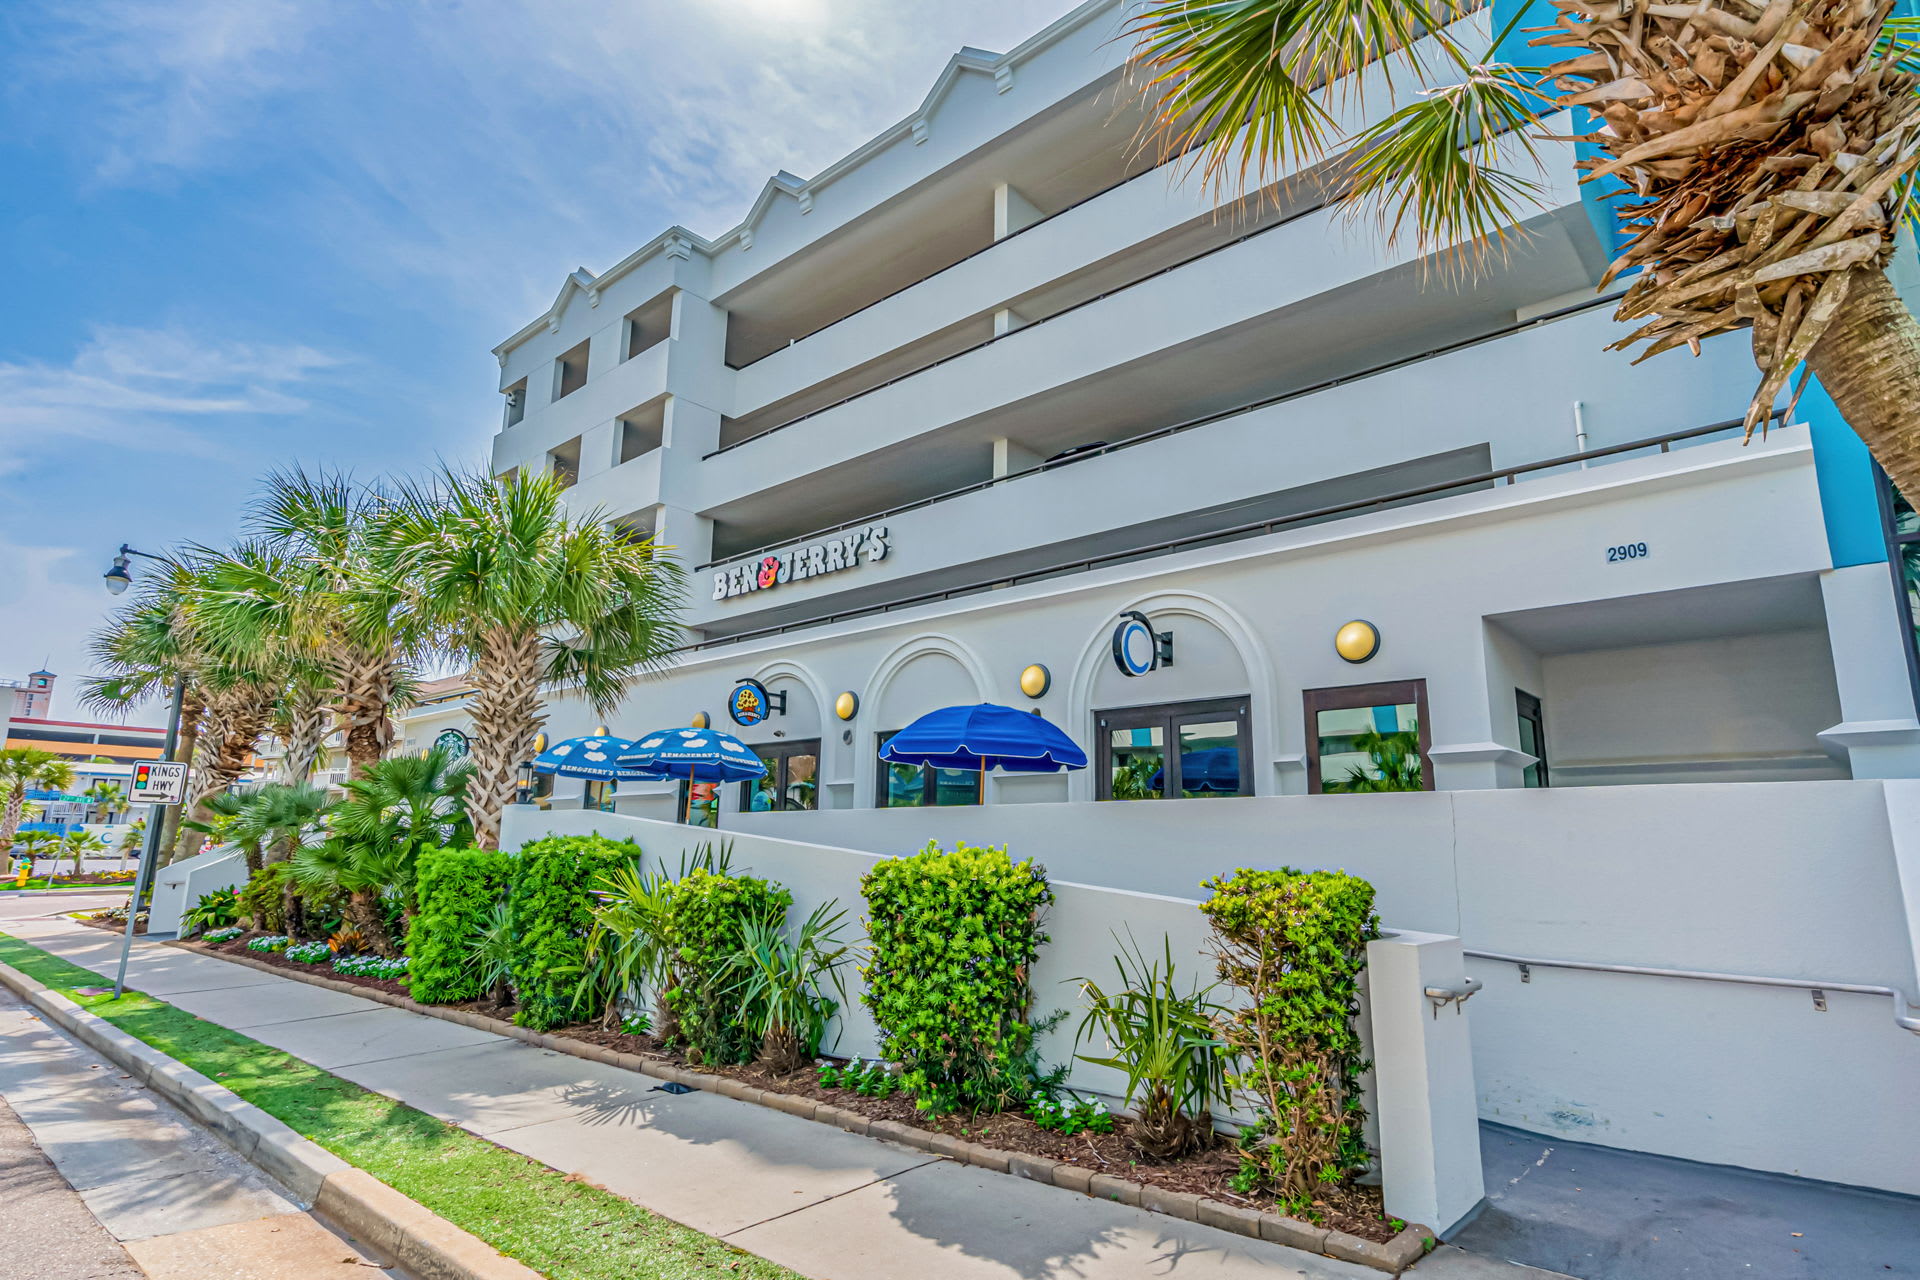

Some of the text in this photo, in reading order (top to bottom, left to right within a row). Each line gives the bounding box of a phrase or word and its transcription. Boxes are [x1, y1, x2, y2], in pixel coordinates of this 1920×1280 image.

[1608, 542, 1647, 562] 2909
[151, 766, 180, 777] KINGS
[152, 781, 174, 791] HWY
